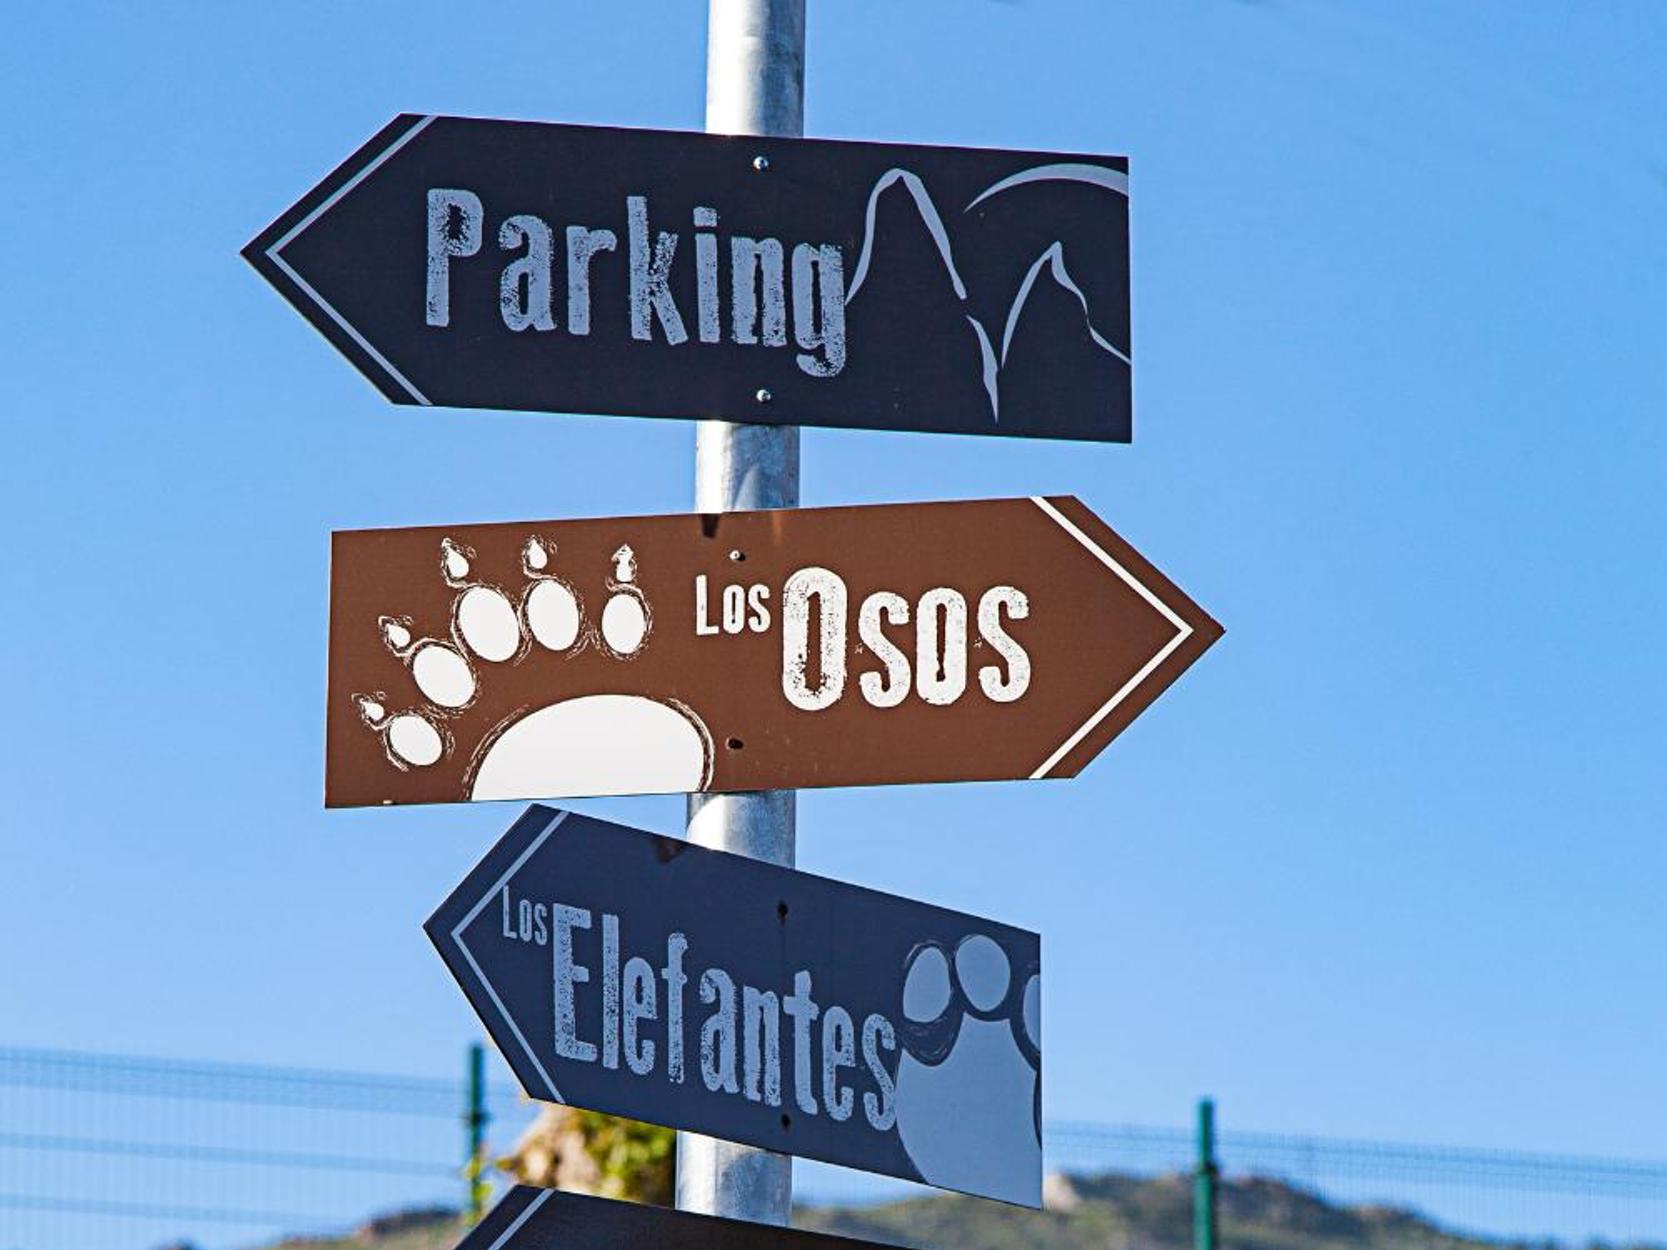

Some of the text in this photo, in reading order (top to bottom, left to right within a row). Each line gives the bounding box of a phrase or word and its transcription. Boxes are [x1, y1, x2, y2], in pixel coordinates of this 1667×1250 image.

[425, 187, 847, 378] Parking
[695, 565, 1032, 712] Los Osos
[502, 886, 899, 1132] Los Elefantes
